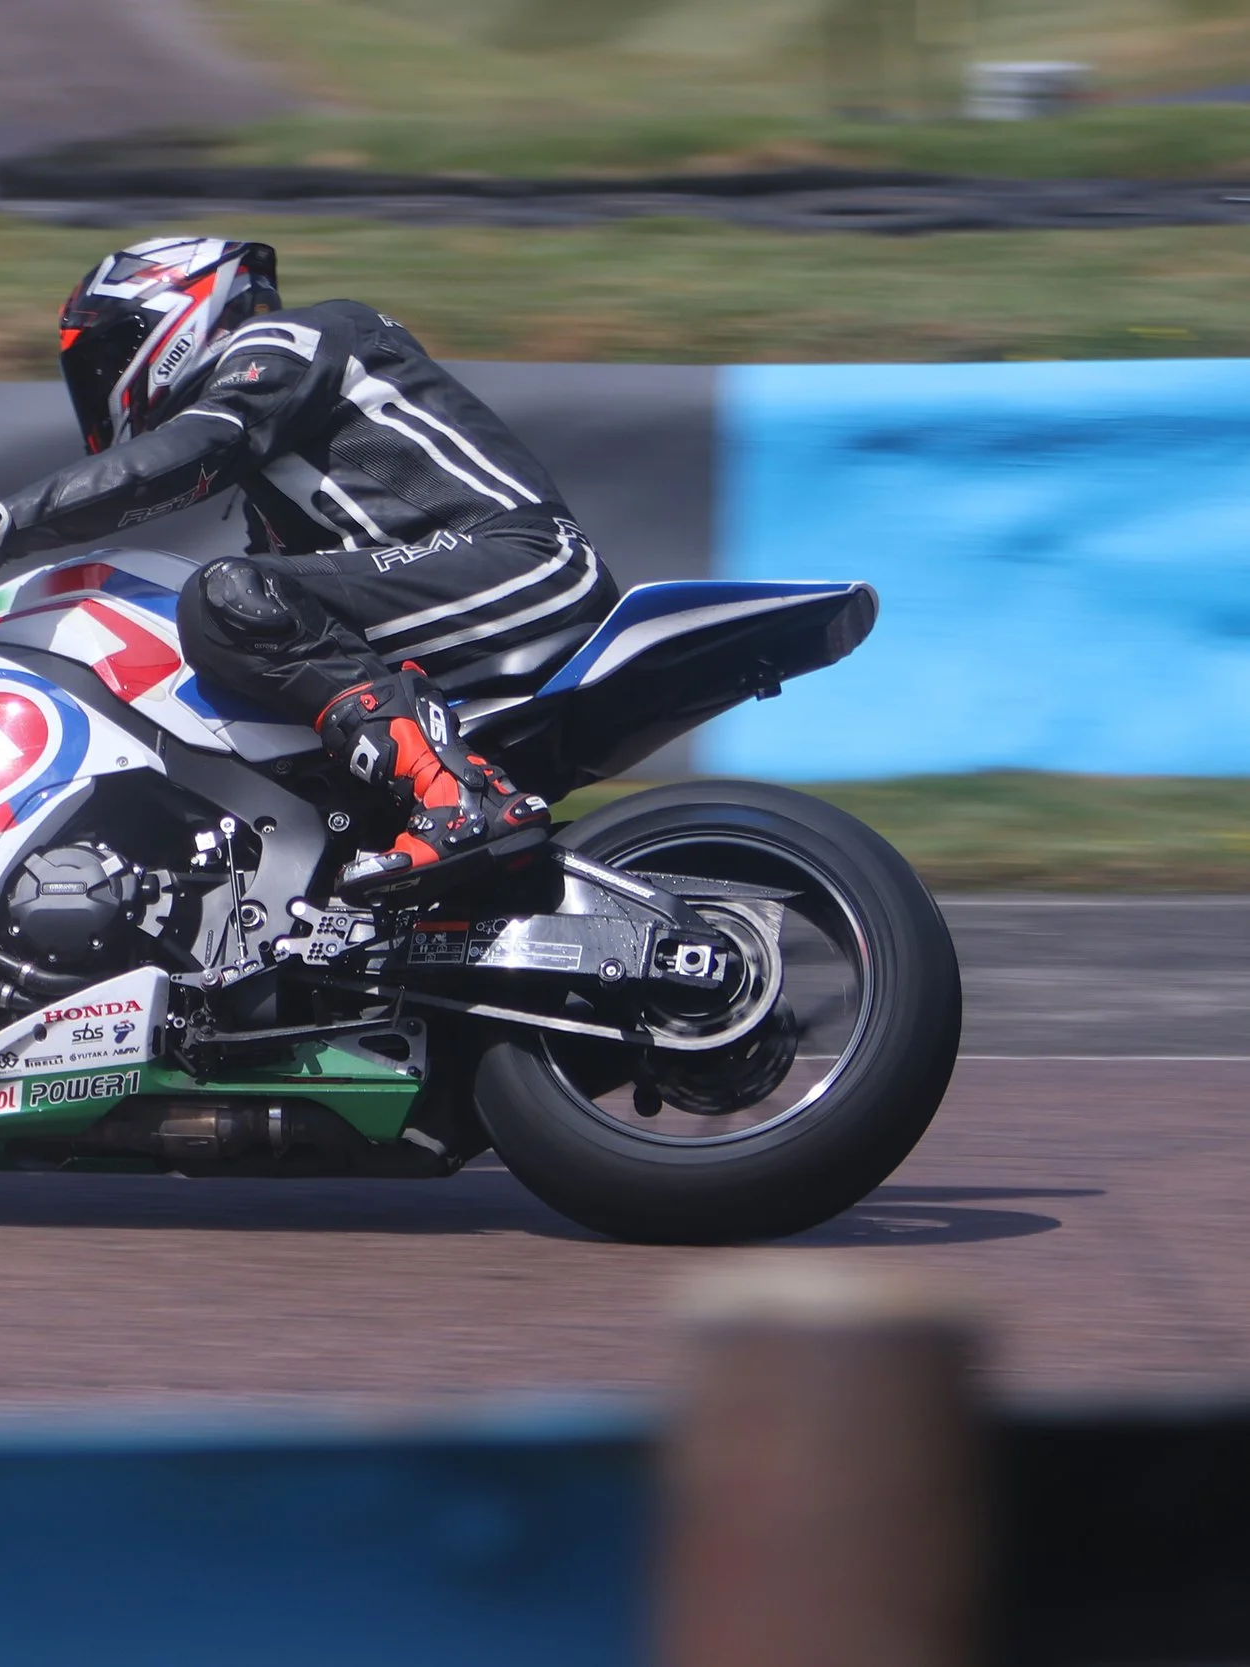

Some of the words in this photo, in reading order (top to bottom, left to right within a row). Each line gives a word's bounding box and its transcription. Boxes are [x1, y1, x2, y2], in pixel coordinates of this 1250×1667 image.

[157, 338, 191, 379] SHOEI
[43, 1000, 144, 1024] HONDA
[72, 1022, 104, 1043] sbs
[24, 1054, 64, 1068] PIRELLI
[77, 1050, 109, 1060] YUTAKA
[30, 1070, 140, 1107] POWER1
